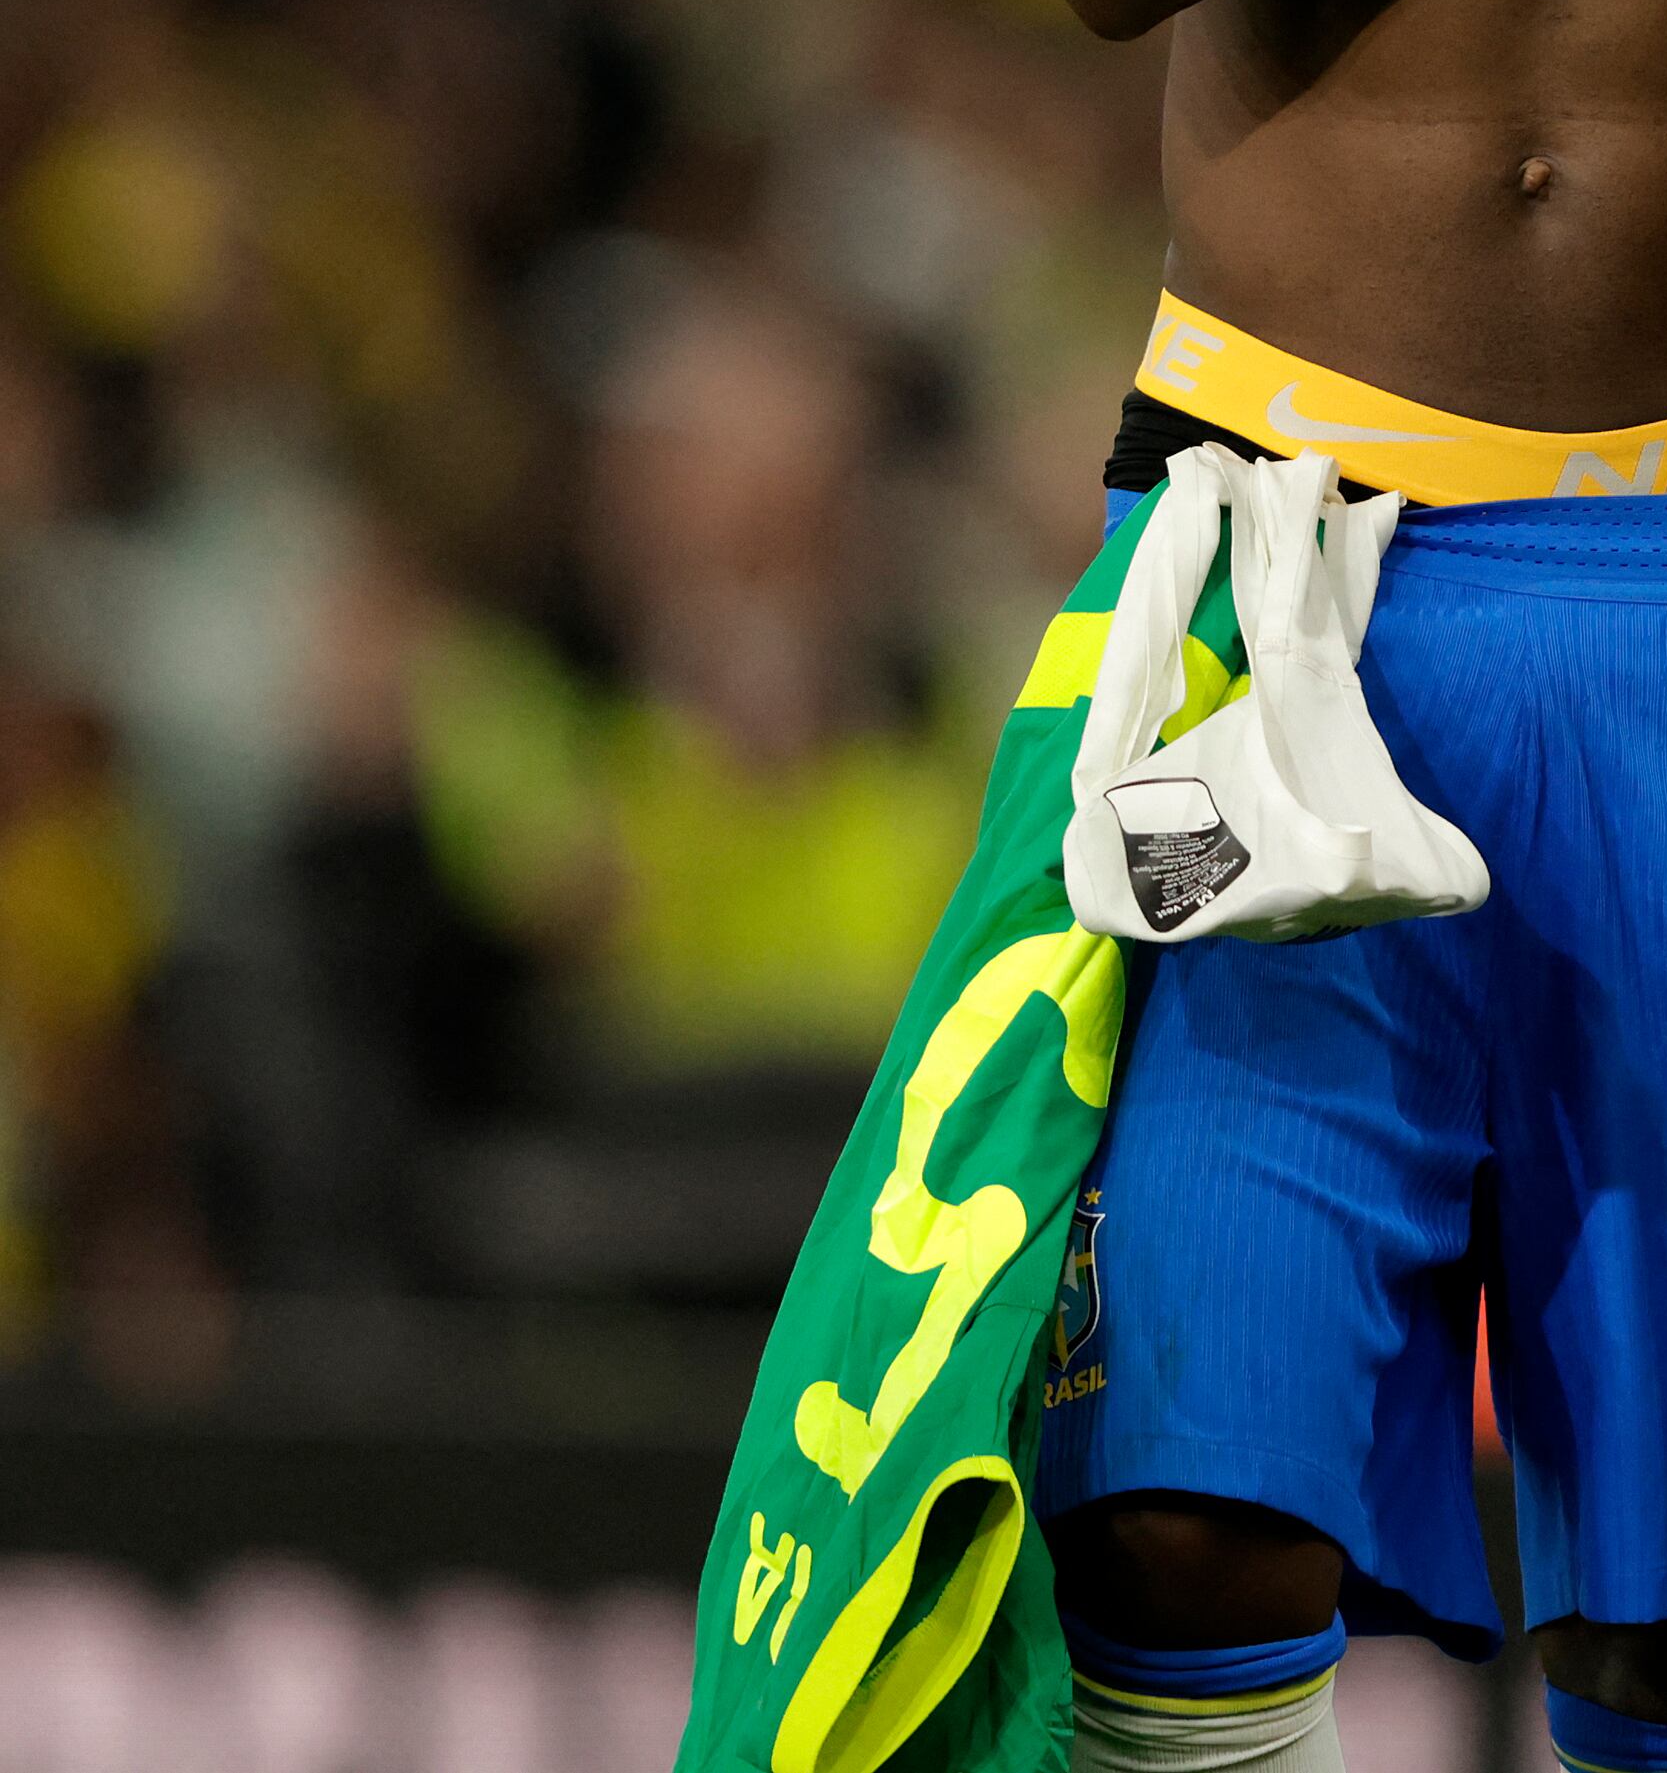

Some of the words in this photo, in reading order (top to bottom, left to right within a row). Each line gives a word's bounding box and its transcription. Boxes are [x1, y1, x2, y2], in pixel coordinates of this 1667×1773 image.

[1209, 858, 1239, 886] Vector
[1182, 887, 1207, 906] Core
[1196, 889, 1215, 907] M
[1156, 905, 1182, 919] Vest
[1043, 1363, 1107, 1409] RASIL
